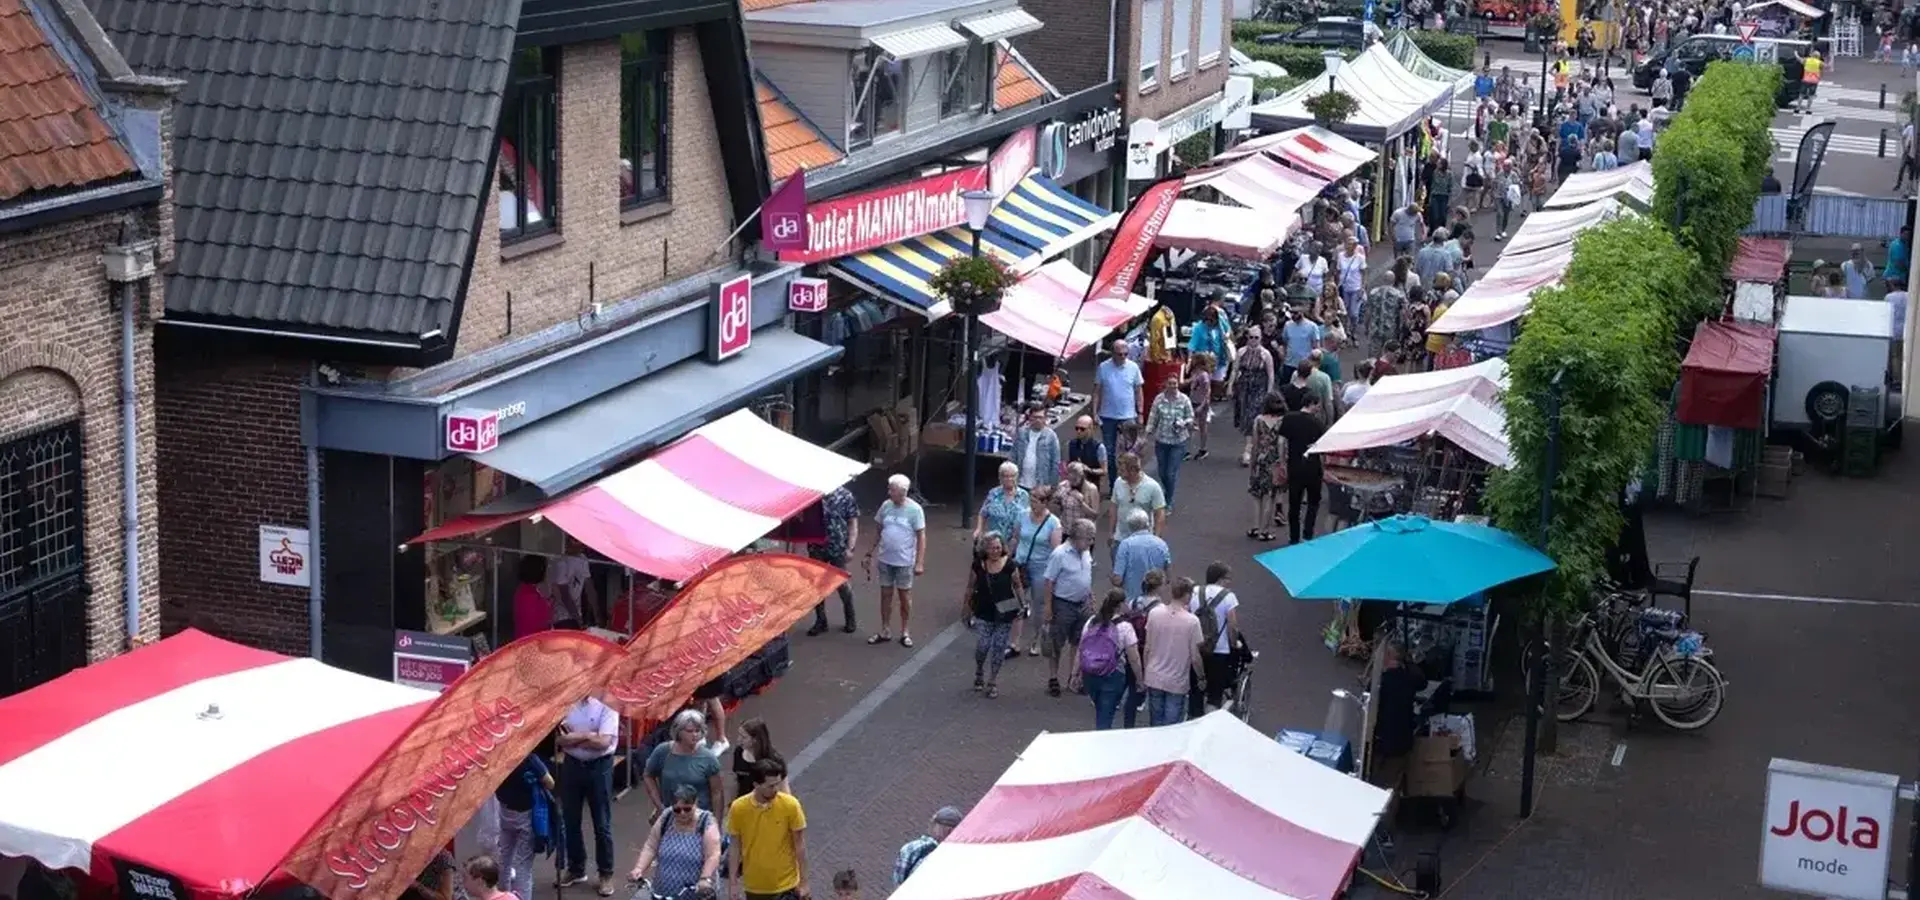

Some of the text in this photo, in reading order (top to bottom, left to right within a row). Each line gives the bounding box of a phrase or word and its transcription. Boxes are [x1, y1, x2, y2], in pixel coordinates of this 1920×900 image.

[773, 217, 798, 238] da
[793, 287, 813, 305] da
[722, 291, 748, 343] da
[450, 421, 476, 446] da
[1770, 800, 1880, 849] Jola
[1797, 856, 1848, 876] mode
